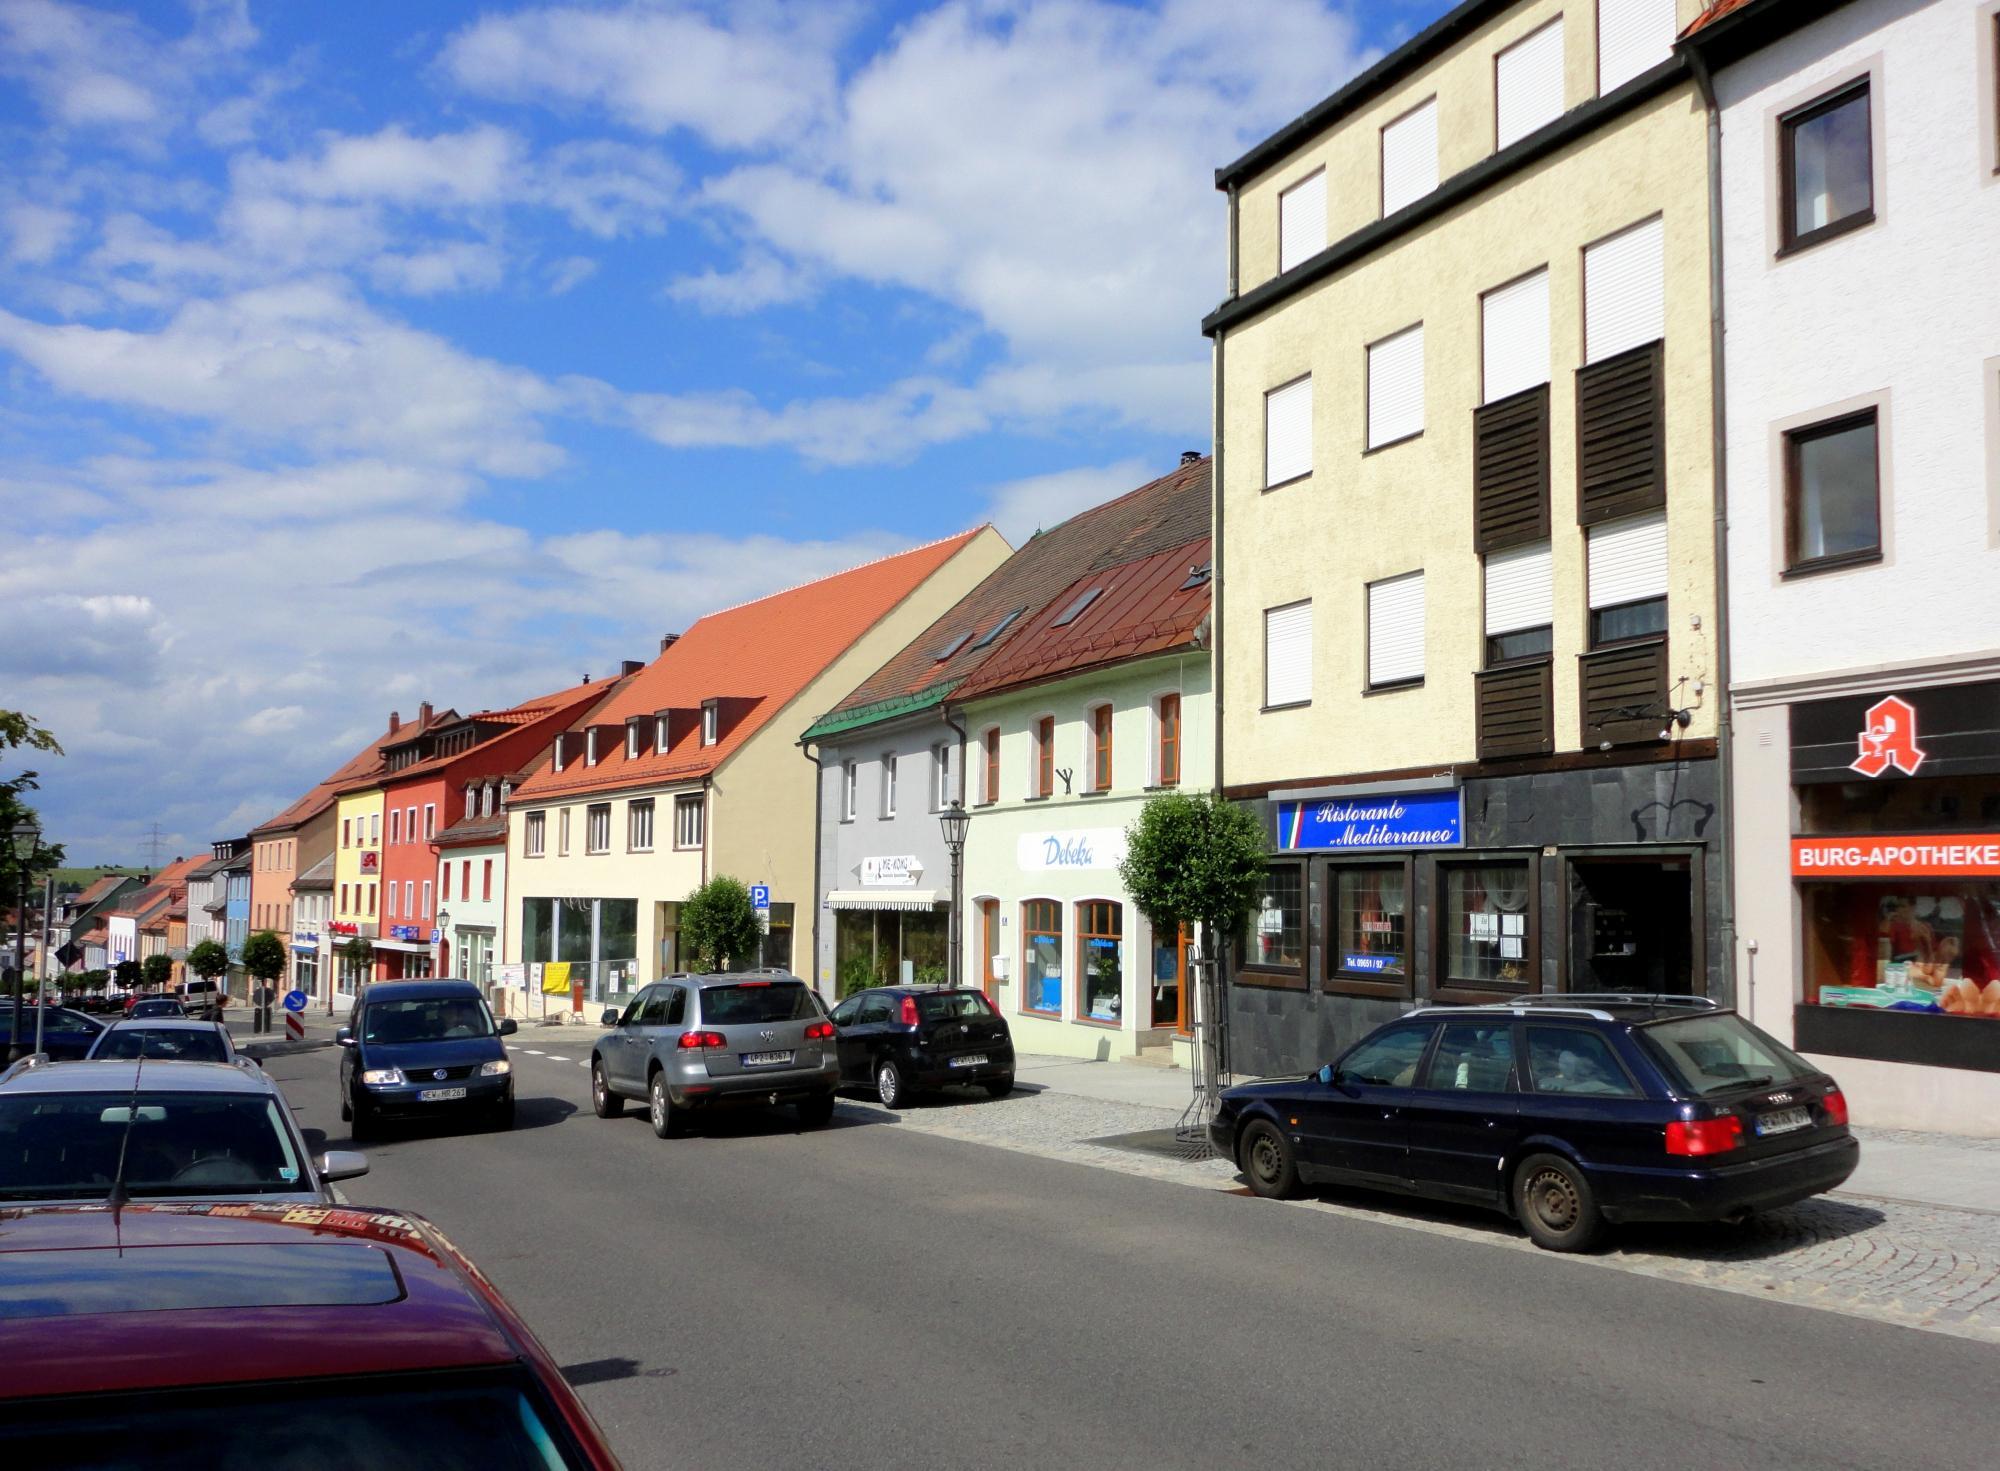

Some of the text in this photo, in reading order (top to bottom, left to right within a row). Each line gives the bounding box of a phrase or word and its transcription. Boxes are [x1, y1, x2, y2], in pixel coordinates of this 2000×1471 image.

[1316, 800, 1406, 823] Ristorante
[1043, 835, 1093, 866] Debeka
[1799, 845, 1999, 867] BURG-APOTHEKE
[755, 888, 765, 905] P
[1347, 958, 1356, 967] Tel.
